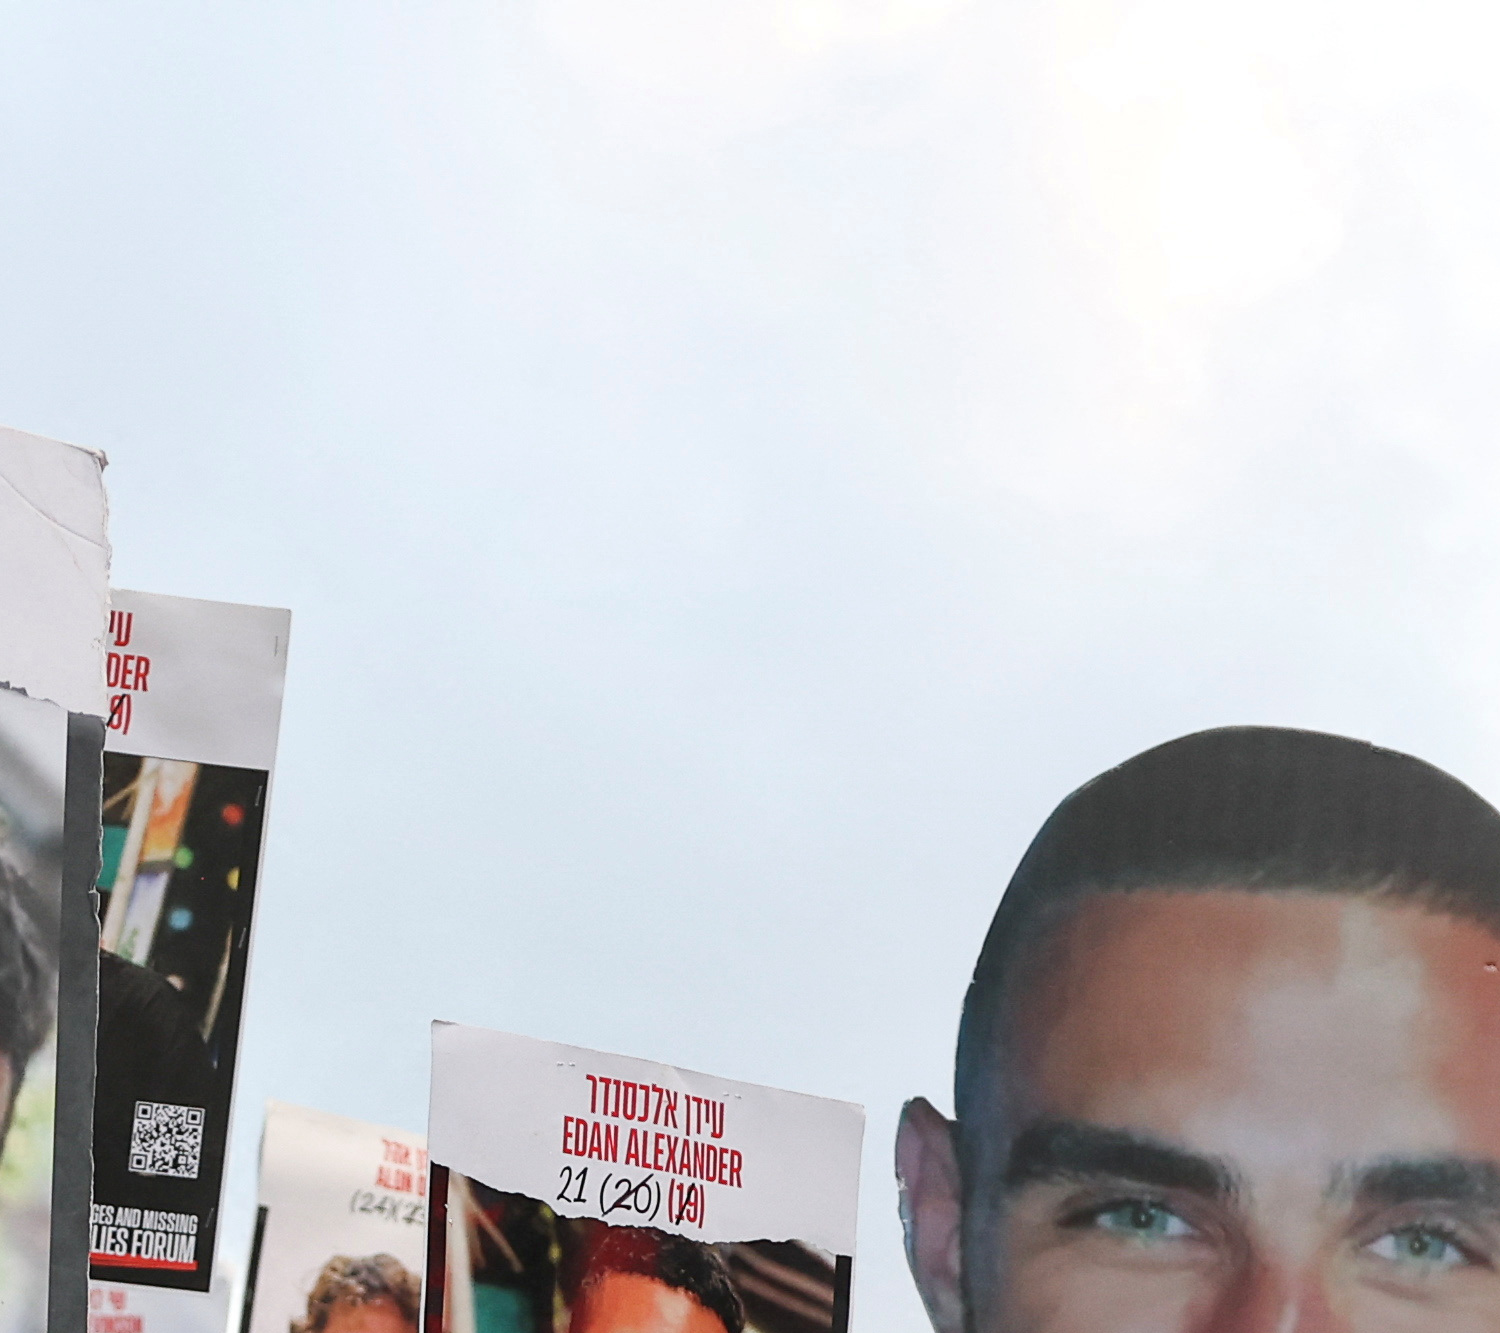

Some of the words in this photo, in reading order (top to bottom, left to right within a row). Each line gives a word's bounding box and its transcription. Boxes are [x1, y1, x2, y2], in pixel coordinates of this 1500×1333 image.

[586, 1073, 679, 1130] אלכסנדר
[684, 1093, 725, 1139] עידן
[562, 1115, 619, 1163] EDAN
[625, 1129, 743, 1188] ALEXANDER
[556, 1166, 588, 1203] 21
[115, 1207, 141, 1228] AND
[142, 1210, 199, 1235] MISSING
[130, 1230, 197, 1264] FORUM
